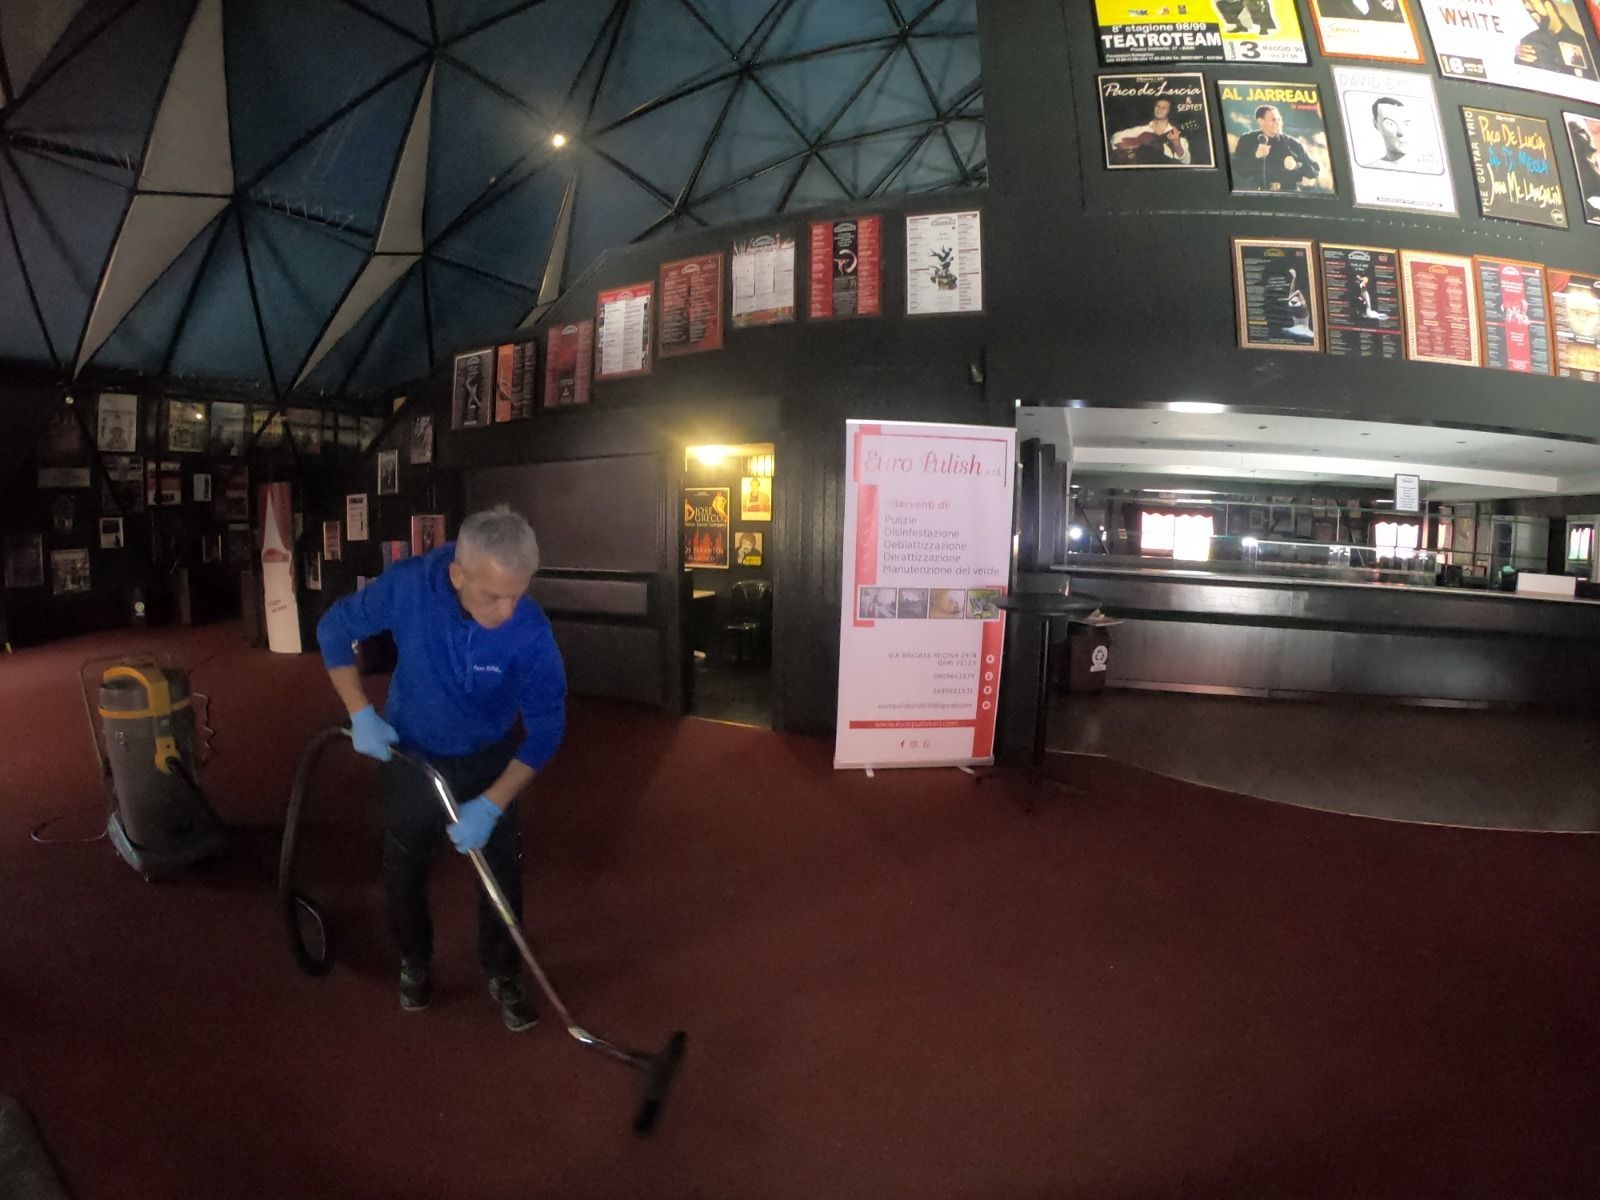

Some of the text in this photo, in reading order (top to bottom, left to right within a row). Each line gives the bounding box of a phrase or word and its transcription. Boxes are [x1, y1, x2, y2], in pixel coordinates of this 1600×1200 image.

[1438, 6, 1504, 34] WHITE
[1125, 23, 1173, 34] stagione
[1175, 22, 1207, 32] 98/99
[1101, 32, 1222, 49] TEATROTEAM
[1240, 41, 1261, 60] 3
[1339, 72, 1382, 89] DAVID
[1103, 82, 1136, 97] Paco
[1137, 82, 1156, 96] de
[1222, 87, 1318, 104] AL JARREAU
[1177, 103, 1203, 112] SEPTET
[1464, 111, 1491, 213] THE GUITAR TRIO
[886, 500, 935, 510] nterventi
[884, 514, 918, 525] Pulizie
[884, 527, 960, 539] Disinfestazione
[883, 539, 968, 551] Deblattizzazione
[883, 552, 961, 563] Derattizzazione
[882, 563, 1000, 576] Manutenzione del verde
